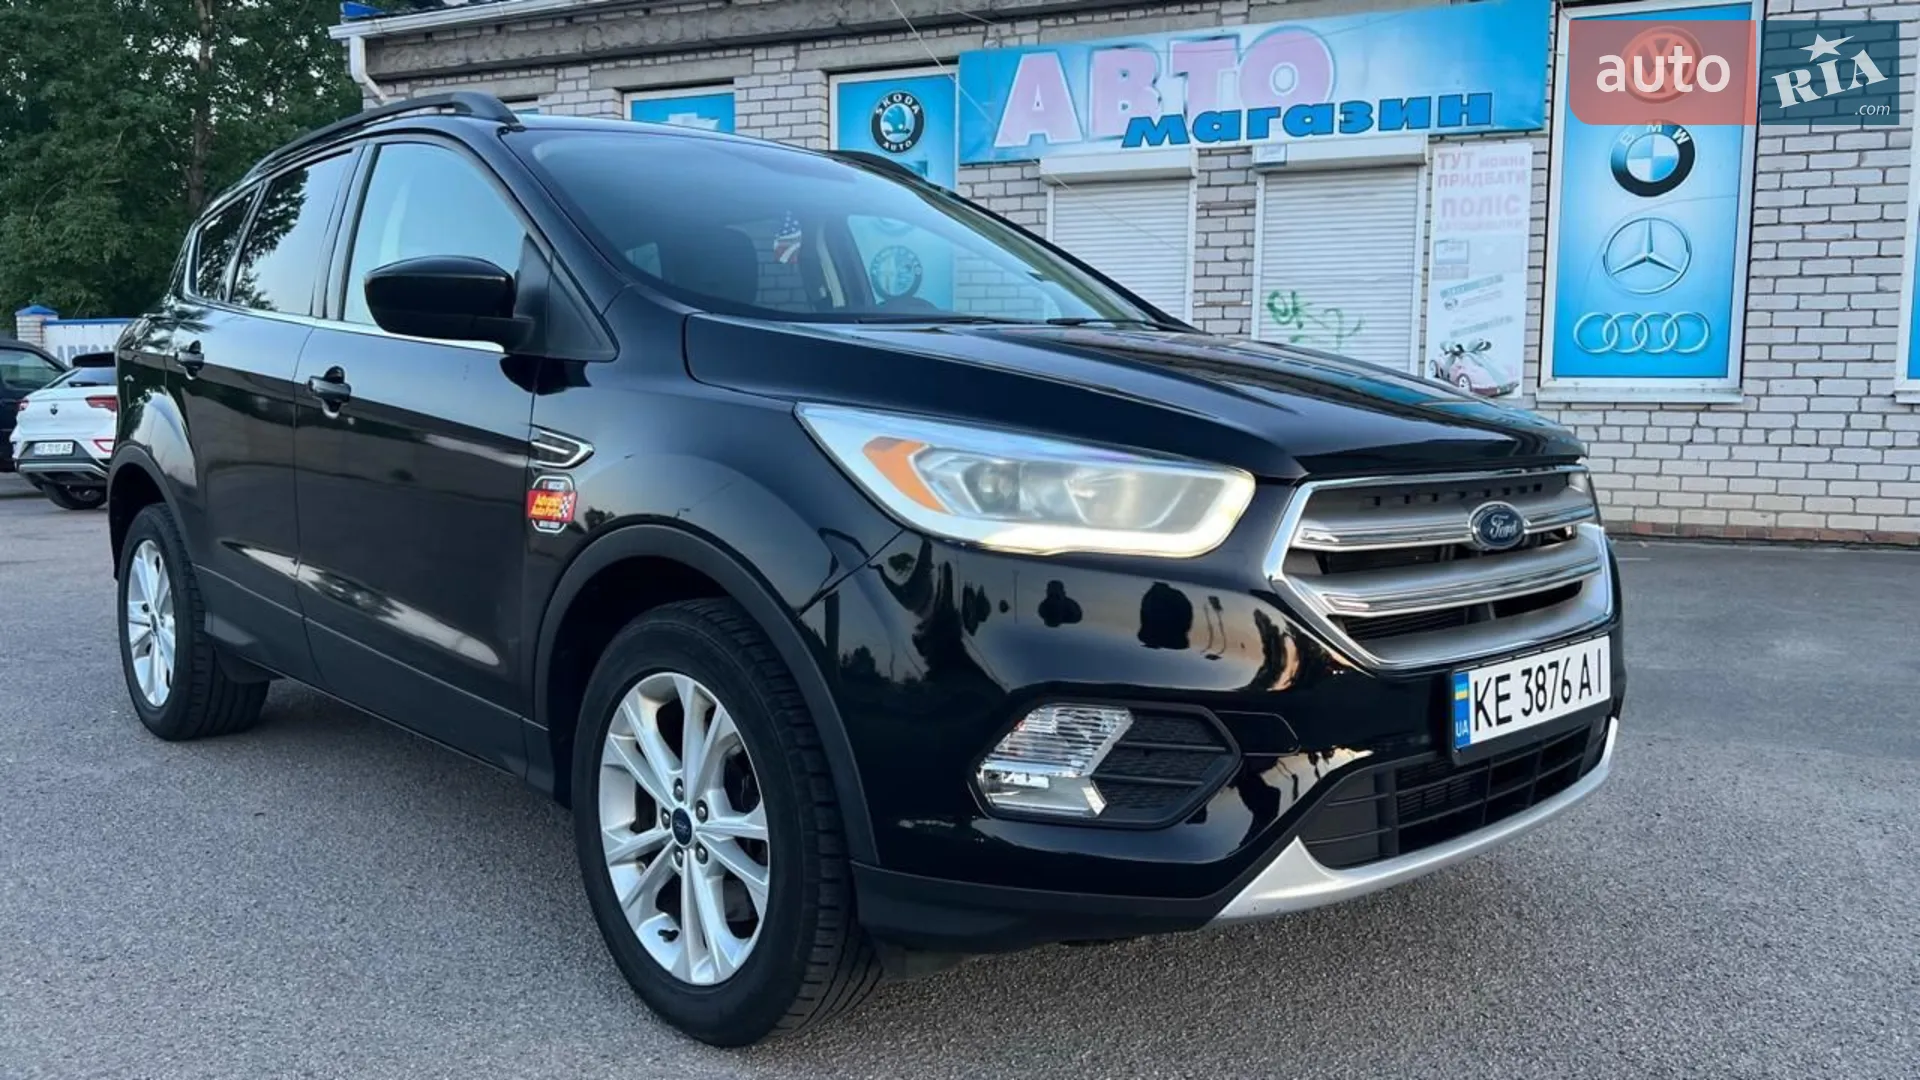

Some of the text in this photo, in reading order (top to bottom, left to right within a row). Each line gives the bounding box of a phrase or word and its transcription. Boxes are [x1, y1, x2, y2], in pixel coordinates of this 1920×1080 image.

[993, 26, 1336, 148] АВТО
[1121, 92, 1493, 148] магазин
[882, 140, 913, 151] AUTO
[1619, 120, 1690, 146] BMW
[1438, 152, 1474, 170] ТУТ
[1437, 169, 1526, 188] ПРИДБАТИ
[1441, 193, 1521, 218] ПОЛІС
[1489, 514, 1518, 539] Ford
[1455, 647, 1602, 738] UA KE 3876 AI
